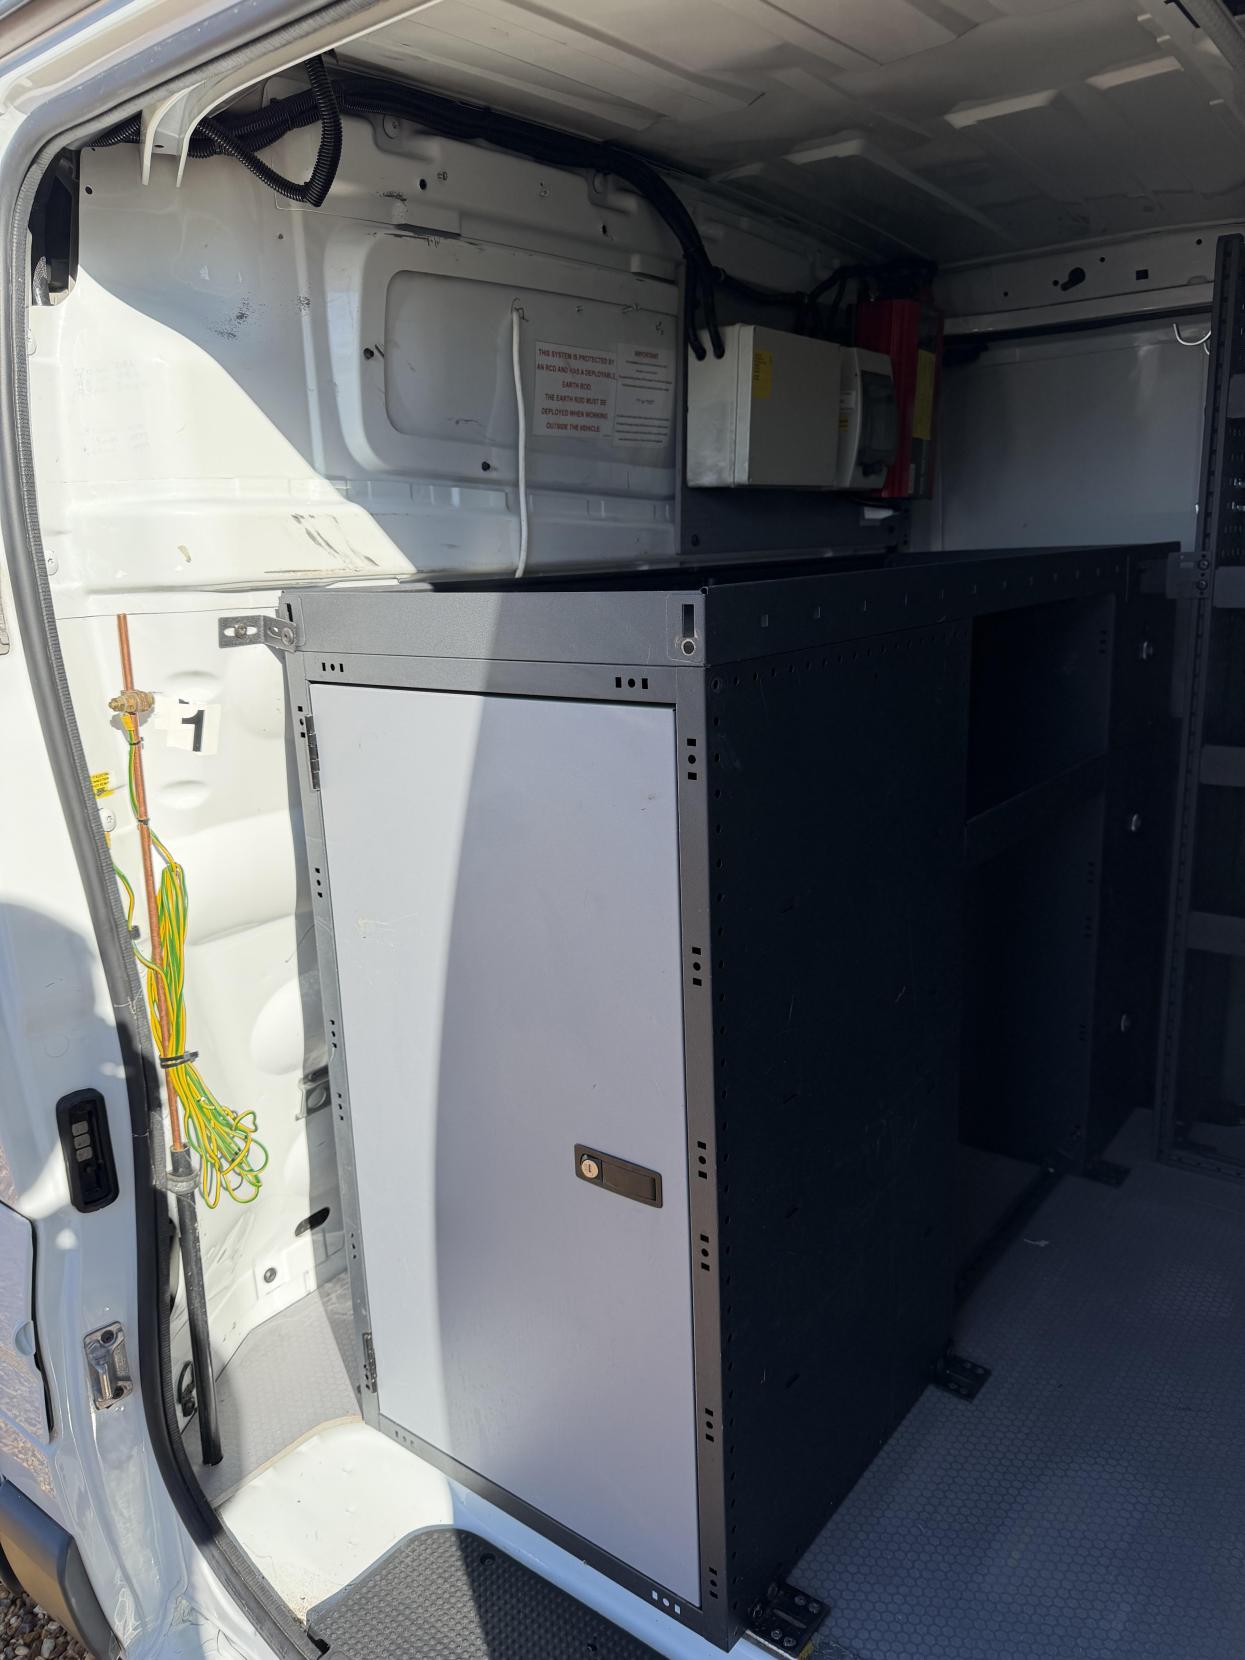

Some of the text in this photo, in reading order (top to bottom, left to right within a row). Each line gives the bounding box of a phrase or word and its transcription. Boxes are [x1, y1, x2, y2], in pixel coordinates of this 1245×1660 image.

[539, 348, 550, 357] THIS
[552, 350, 572, 360] SYSTEM
[579, 354, 608, 365] PROTECTED
[545, 364, 556, 372] RCD
[558, 366, 568, 374] AND
[562, 380, 579, 388] EARTH
[544, 393, 554, 402] THE
[556, 394, 573, 402] EARTH
[575, 396, 585, 404] ROD
[586, 397, 599, 405] MUST
[541, 408, 569, 416] DEPLOYED
[570, 410, 585, 418] WHEN
[586, 411, 608, 420] WORKING
[546, 422, 568, 430] OUTSIDE
[570, 423, 579, 432] THE
